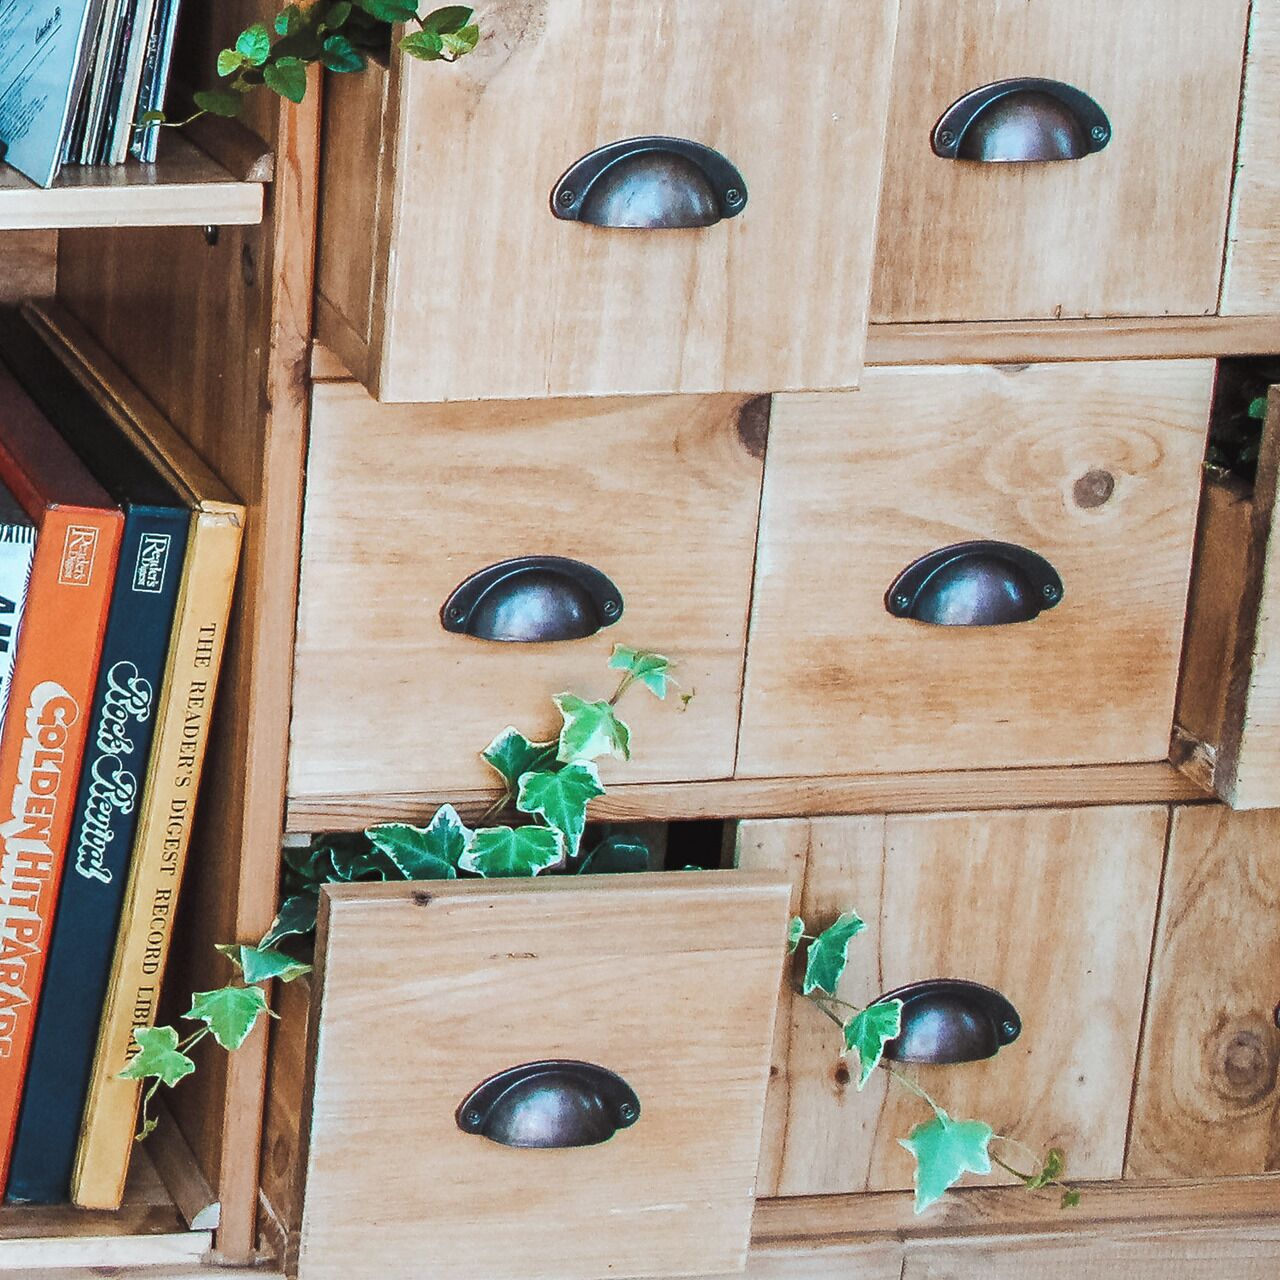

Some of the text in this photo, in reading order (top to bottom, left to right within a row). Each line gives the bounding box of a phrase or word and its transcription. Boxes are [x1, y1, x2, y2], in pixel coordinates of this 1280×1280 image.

[69, 528, 94, 580] Reader's
[143, 536, 167, 588] Reader's
[193, 622, 217, 667] THE
[2, 682, 80, 841] GOLDEN
[176, 679, 209, 776] READER'S
[76, 661, 153, 883] Rock Revival
[158, 790, 190, 876] DIGEST
[0, 841, 54, 920] HIT
[140, 888, 174, 976] RECORD
